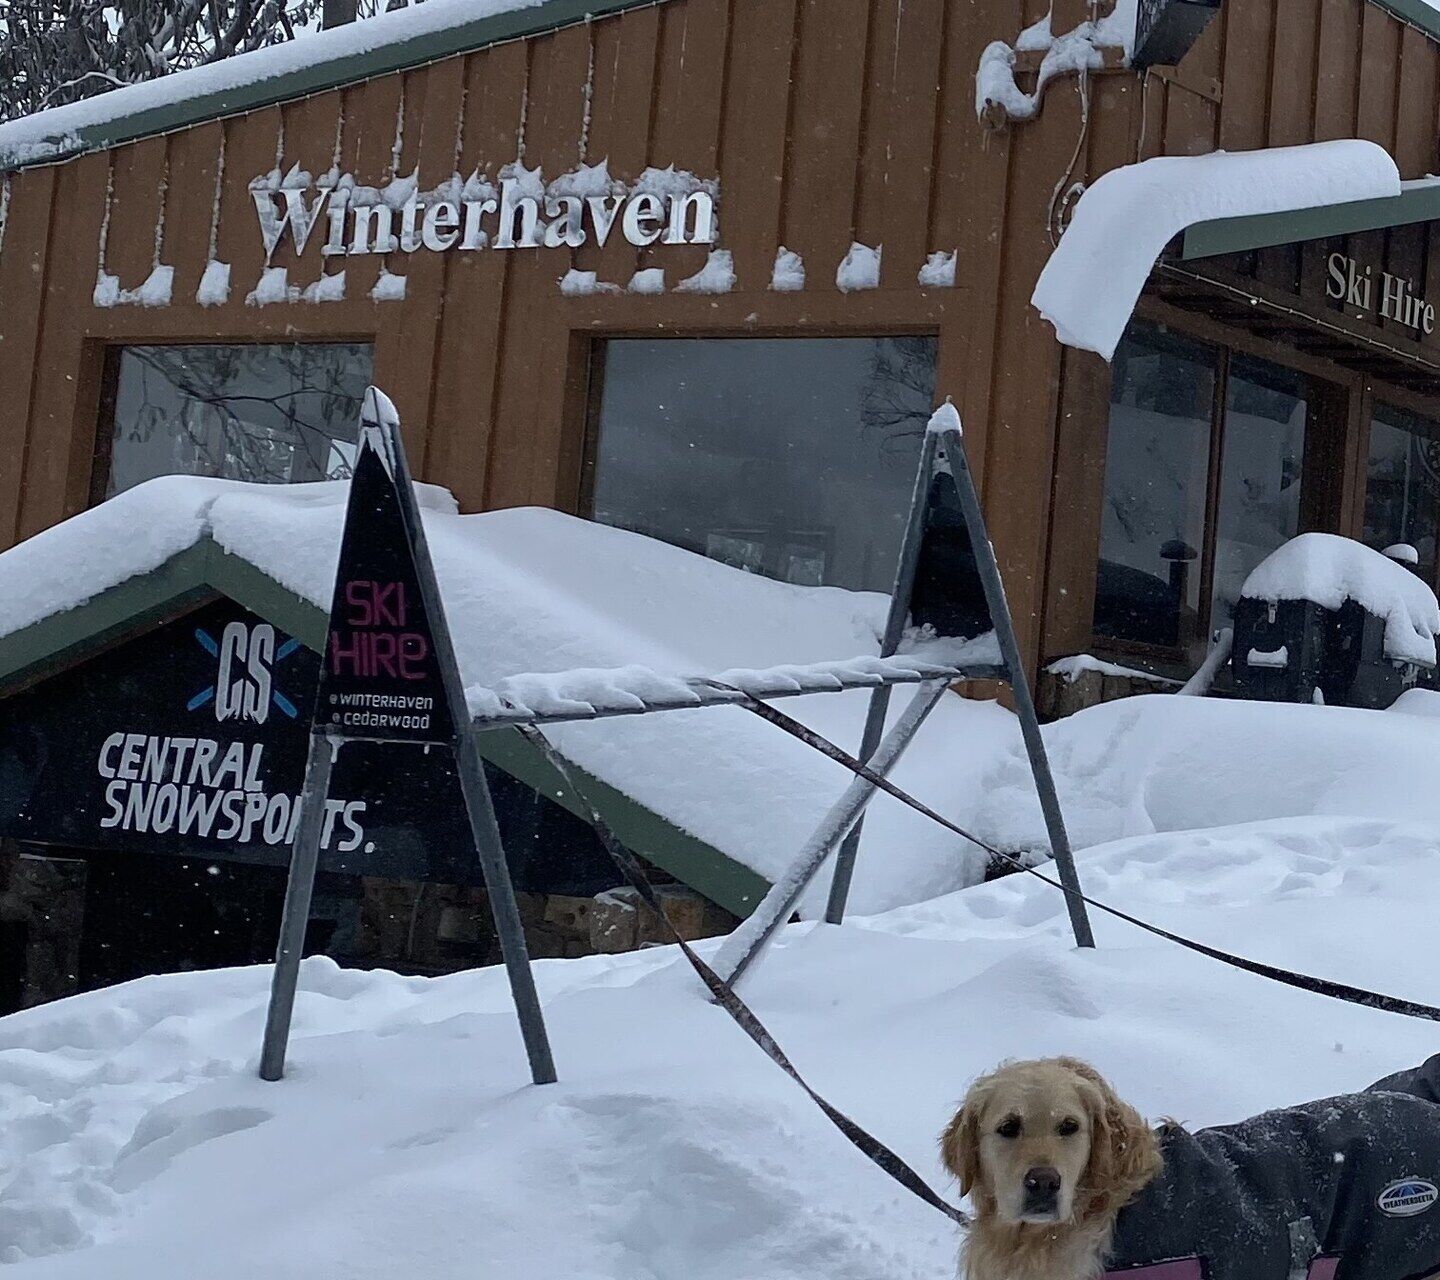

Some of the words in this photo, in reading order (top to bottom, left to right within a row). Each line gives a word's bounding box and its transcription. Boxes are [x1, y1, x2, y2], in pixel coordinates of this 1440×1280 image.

[251, 178, 714, 257] Winterhaven
[1326, 252, 1371, 310] Ski
[1379, 271, 1435, 335] Hire
[345, 581, 406, 626] SKI
[215, 621, 275, 724] CS
[98, 732, 264, 792] CENTRAL
